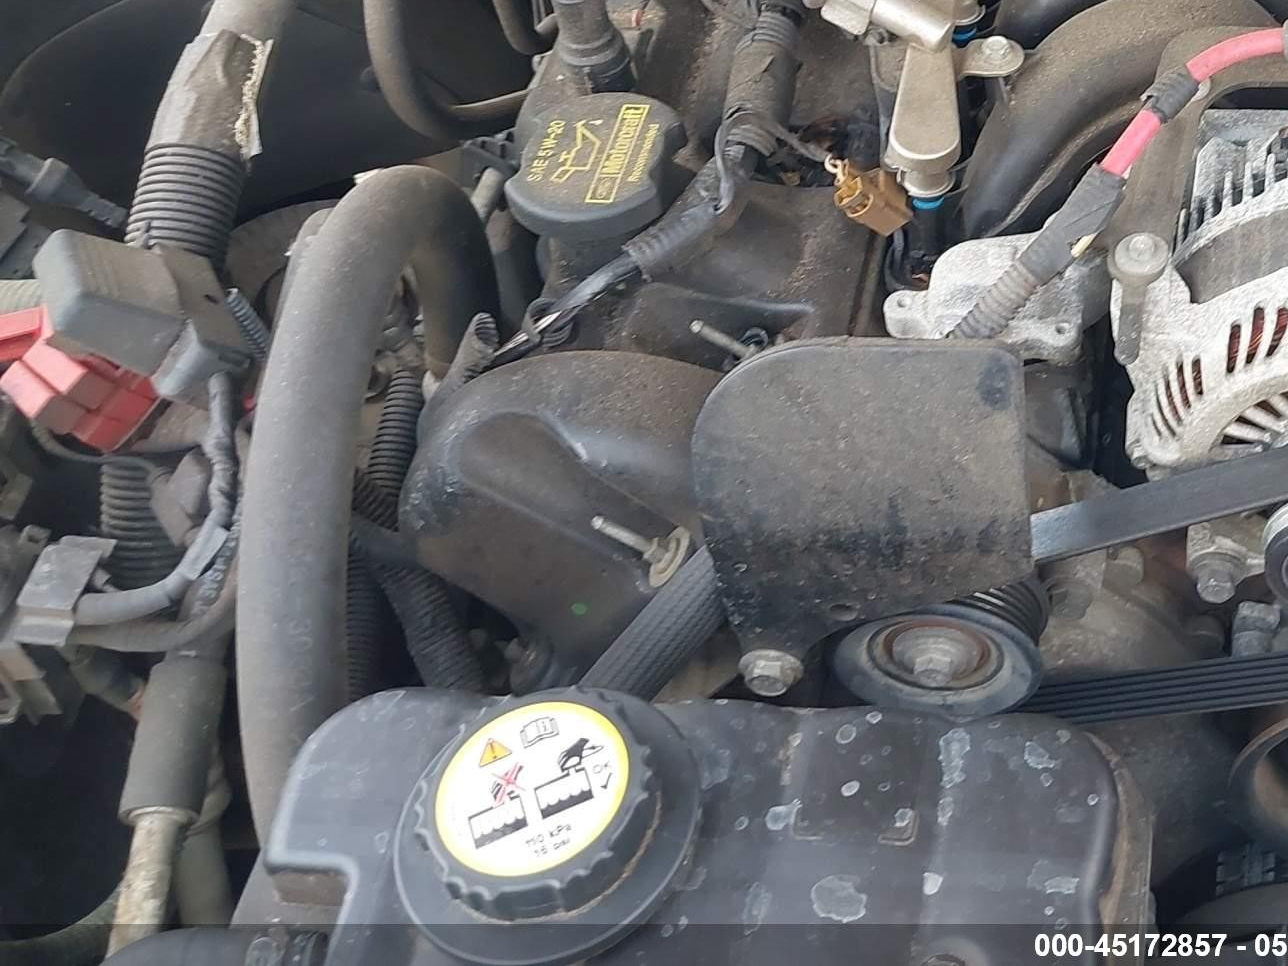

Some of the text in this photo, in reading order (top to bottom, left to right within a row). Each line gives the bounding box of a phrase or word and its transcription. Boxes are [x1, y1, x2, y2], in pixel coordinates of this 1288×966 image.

[526, 120, 566, 182] SAE 5W-20
[601, 106, 645, 176] Motorcraft
